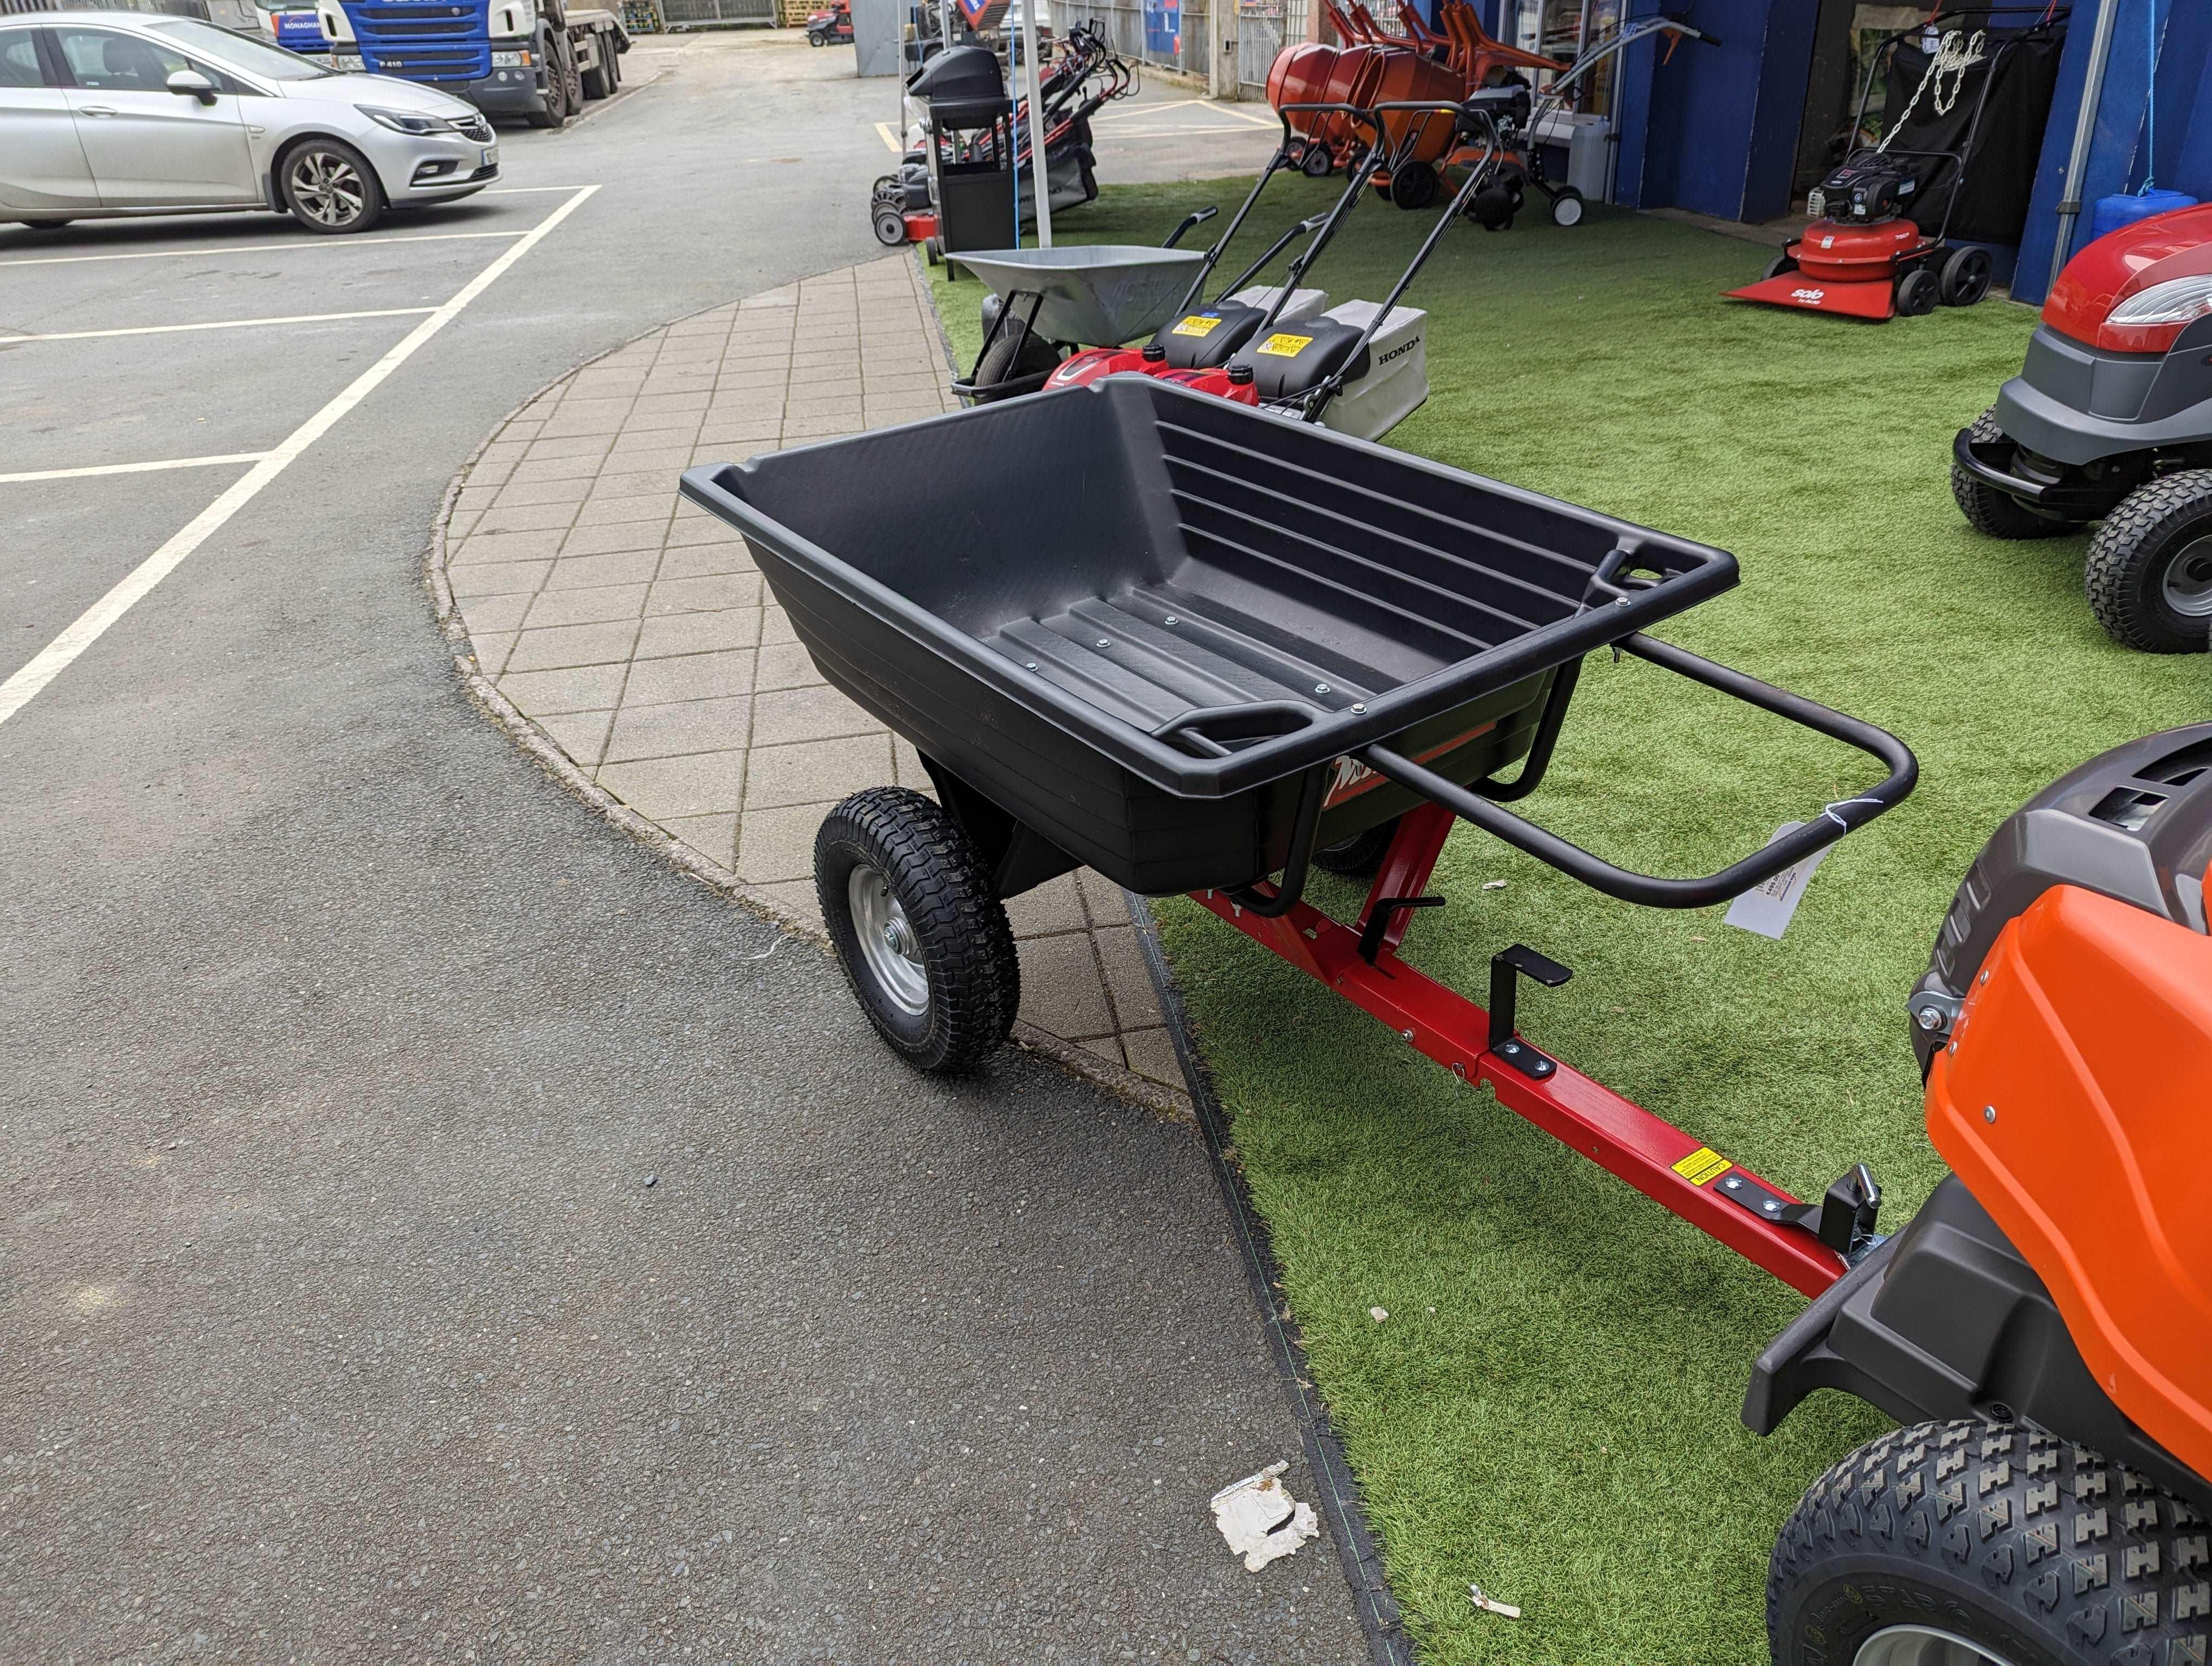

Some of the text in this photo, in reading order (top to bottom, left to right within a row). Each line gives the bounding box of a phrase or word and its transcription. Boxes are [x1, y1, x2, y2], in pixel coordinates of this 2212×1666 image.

[1791, 289, 1824, 299] solo
[1379, 335, 1420, 366] HONDA
[1695, 1163, 1726, 1182] CAUTION
